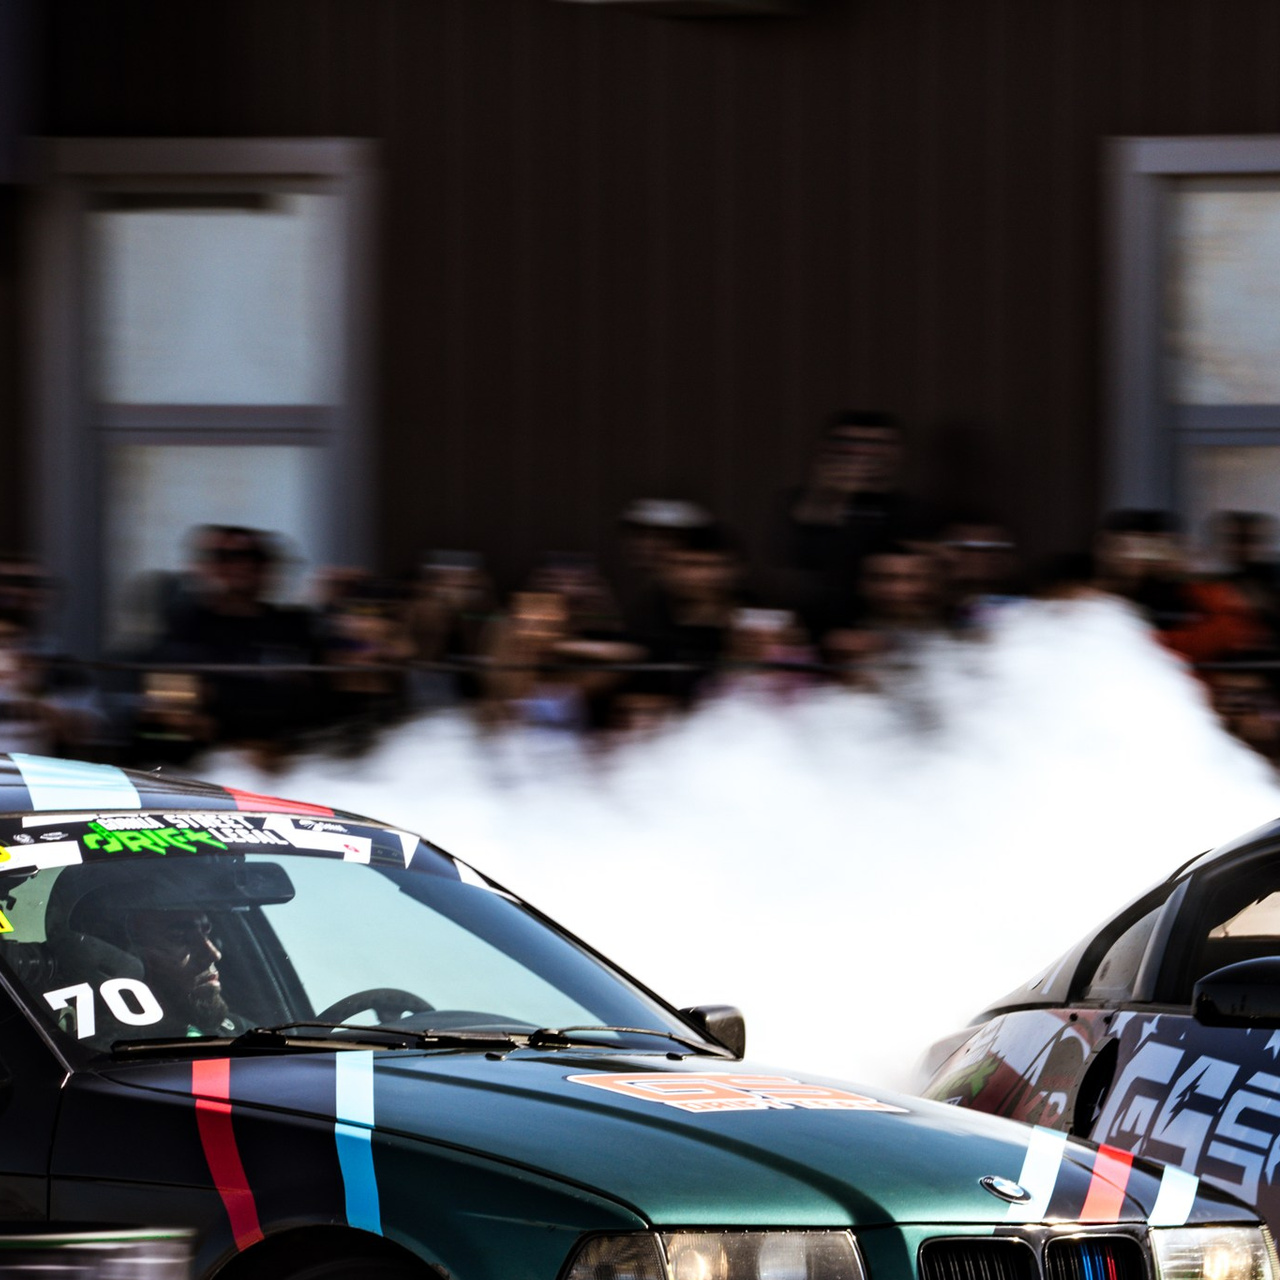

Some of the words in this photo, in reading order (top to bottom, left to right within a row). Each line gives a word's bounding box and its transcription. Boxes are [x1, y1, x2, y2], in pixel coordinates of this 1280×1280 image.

[163, 814, 255, 830] STREET
[208, 827, 290, 846] LEGAL
[42, 977, 164, 1040] 70
